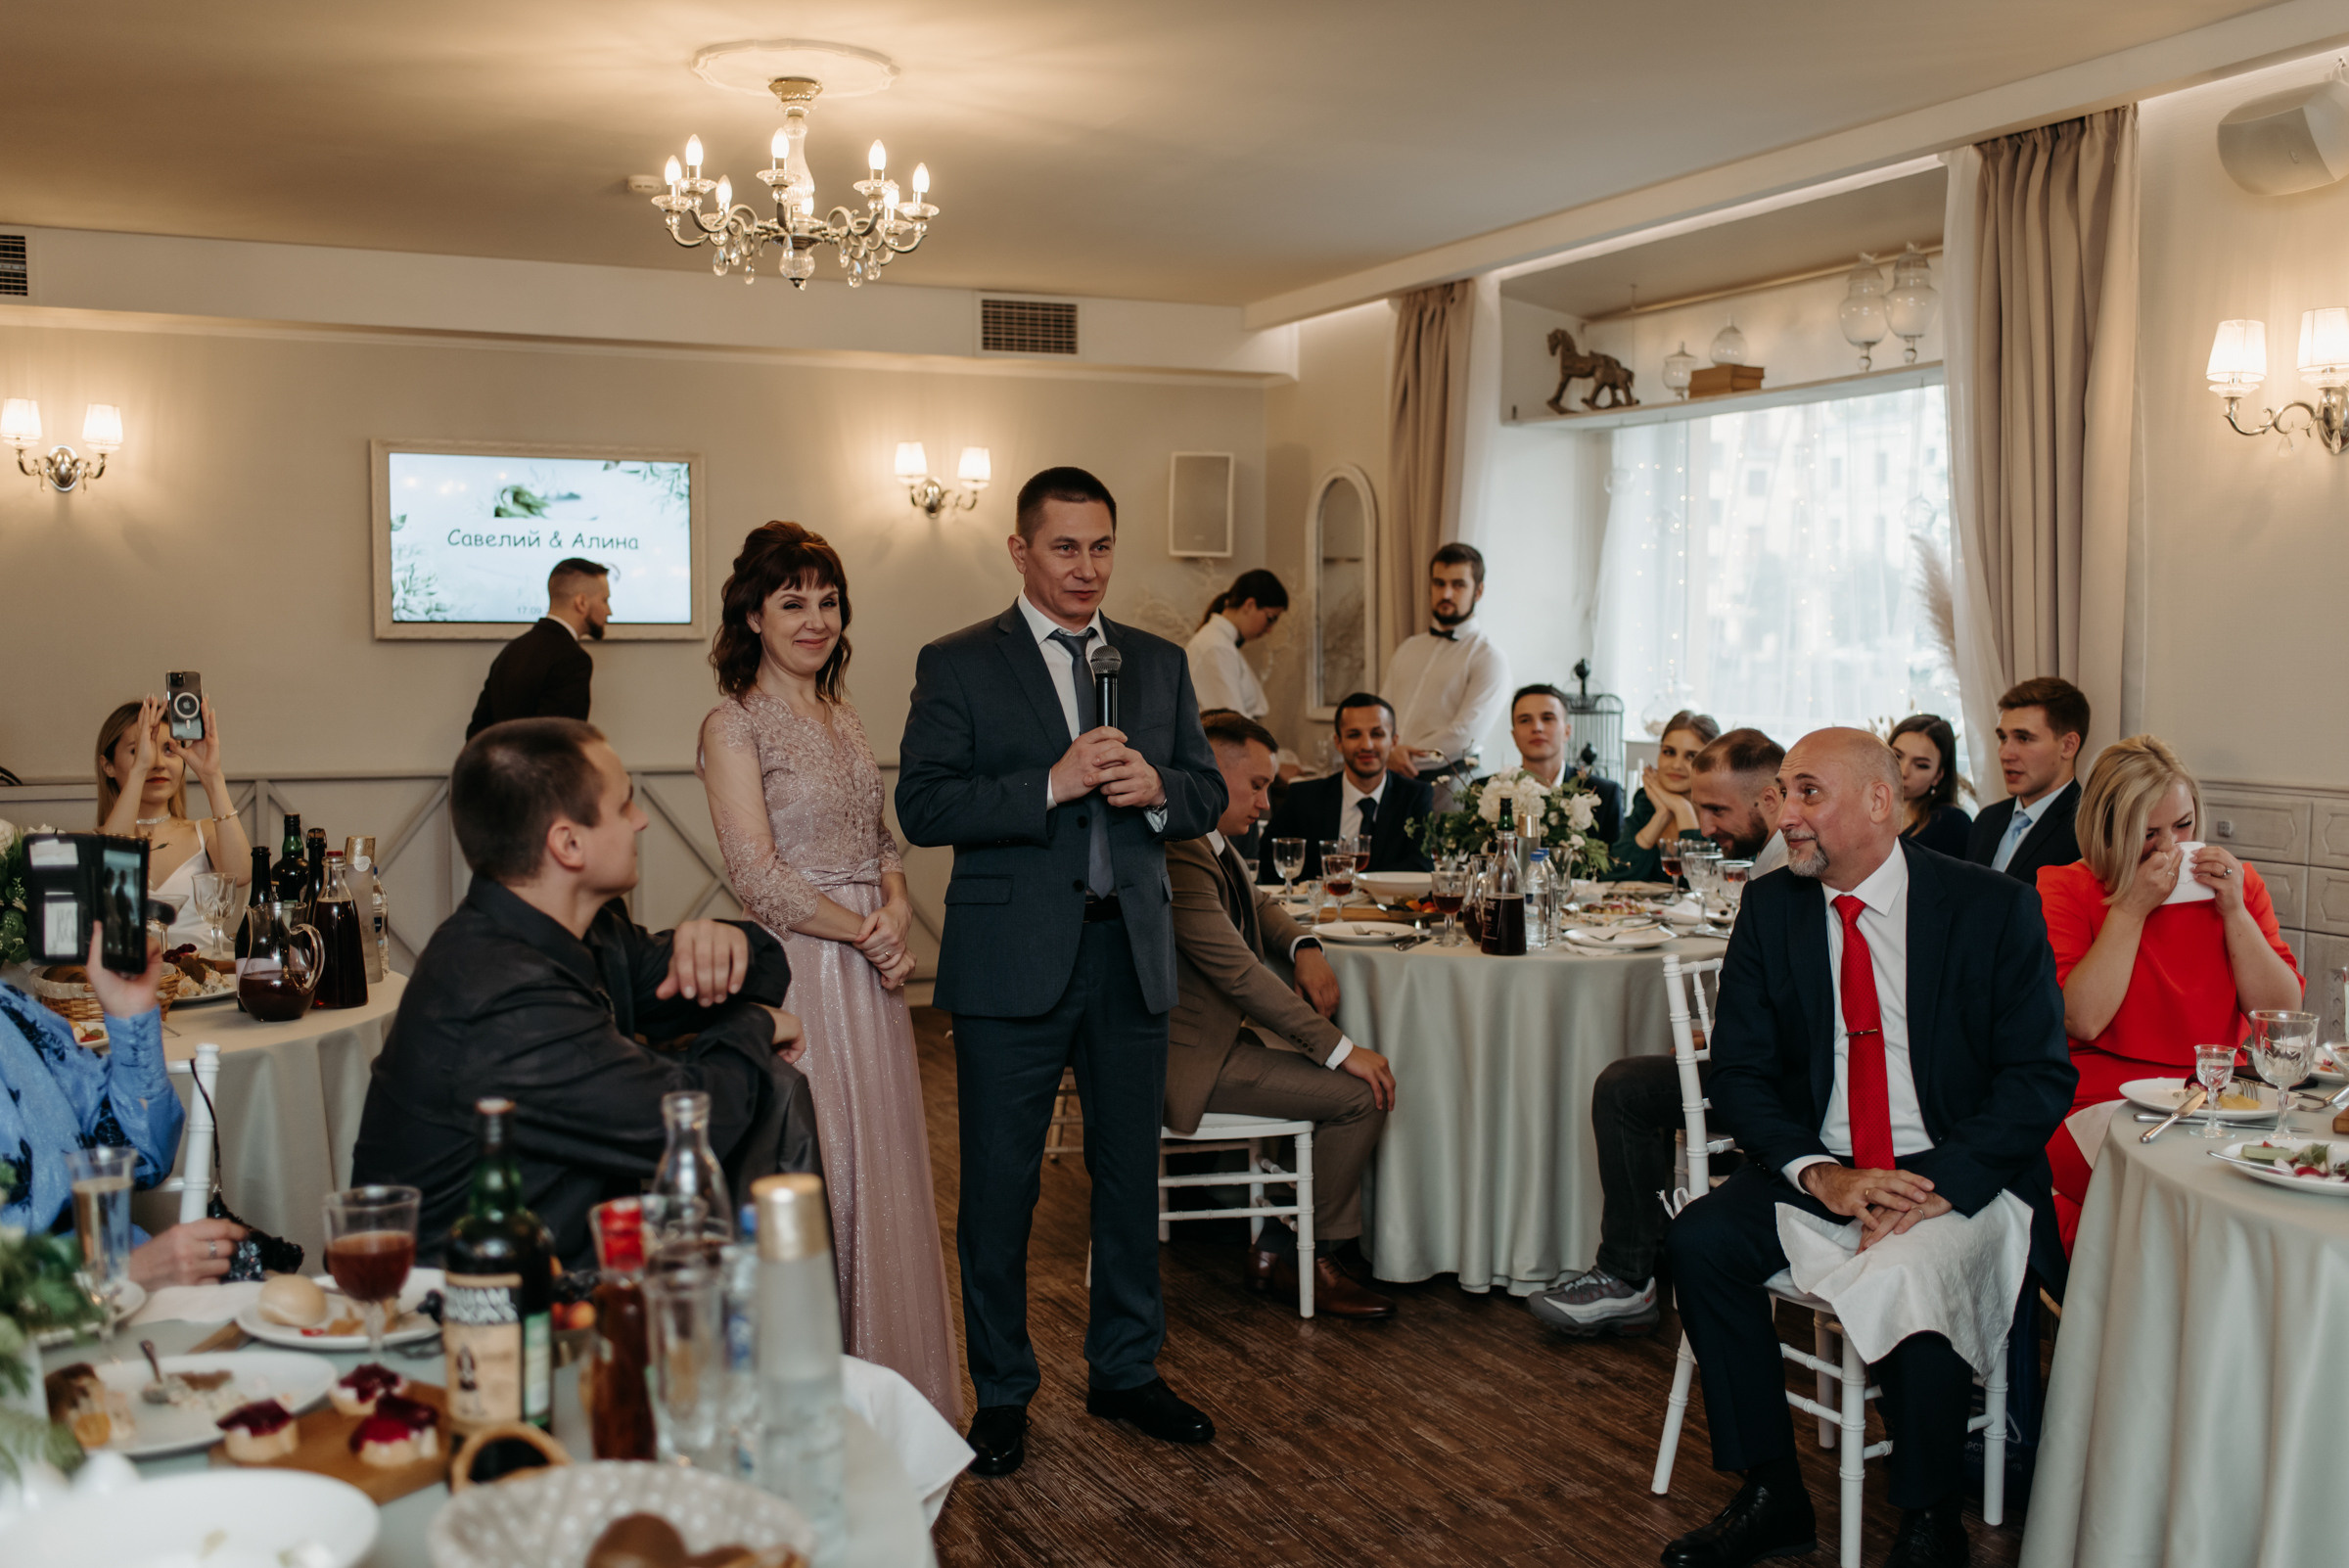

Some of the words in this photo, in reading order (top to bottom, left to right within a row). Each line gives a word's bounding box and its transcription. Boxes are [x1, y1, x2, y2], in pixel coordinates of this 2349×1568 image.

[447, 529, 541, 547] Савелий
[549, 530, 563, 548] &
[572, 532, 640, 550] Алина
